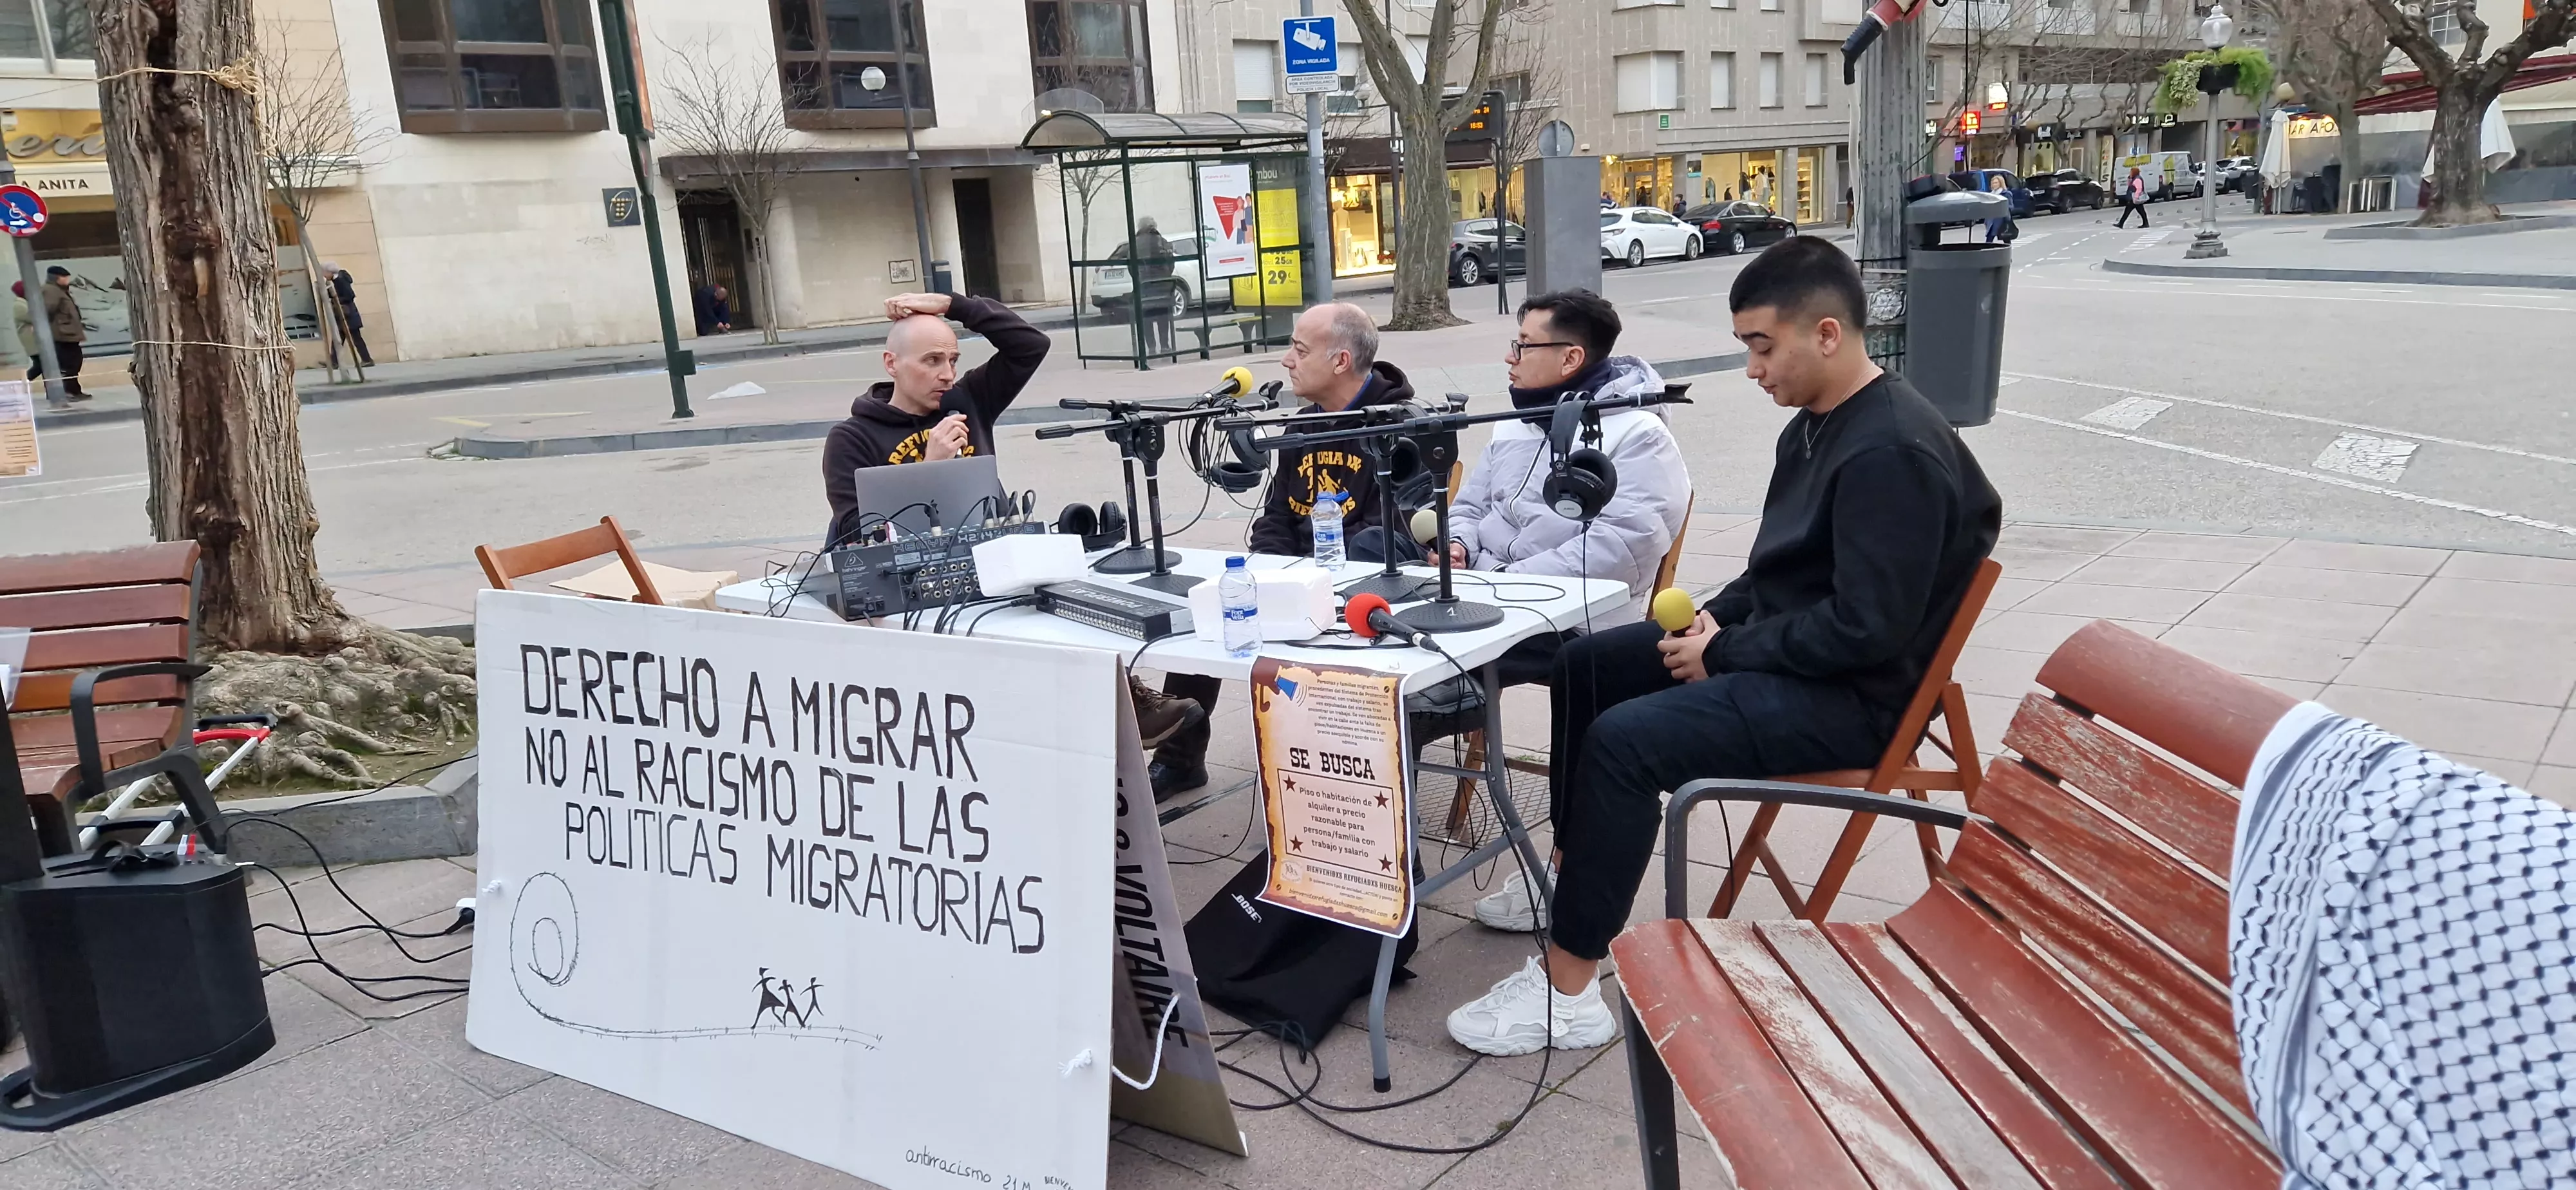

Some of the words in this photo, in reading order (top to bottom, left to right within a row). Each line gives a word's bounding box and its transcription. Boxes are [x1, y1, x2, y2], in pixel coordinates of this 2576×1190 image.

[38, 178, 90, 191] ANITA
[1066, 588, 1143, 609] POWERPLAY
[520, 644, 720, 738] DERECHO
[742, 672, 776, 748] A
[791, 676, 979, 782] MIGRAR
[1290, 747, 1310, 770] SE
[1320, 751, 1376, 780] BUSCA
[526, 726, 567, 788] NO
[582, 735, 624, 798] AL
[635, 738, 797, 826] RACISMO
[819, 766, 875, 842] DE
[898, 781, 990, 863] LAS
[1300, 787, 1314, 796] Piso
[1322, 791, 1361, 804] habitación
[1308, 801, 1334, 811] alquiler
[1343, 808, 1365, 818] precio
[1303, 826, 1360, 843] persona/familia
[1311, 815, 1346, 827] razonable
[1348, 822, 1365, 831] para
[1312, 839, 1337, 851] trabajo
[1345, 847, 1368, 858] salario
[566, 802, 737, 885] POLITICAS
[766, 833, 1045, 954] MIGRATORIAS
[1307, 865, 1342, 879] BIENVENIDXS
[1344, 873, 1378, 888] REFUGIADXS
[1379, 882, 1402, 893] HUESCA
[1232, 893, 1262, 923] BOSE
[1115, 864, 1189, 1048] VOLTAIRE
